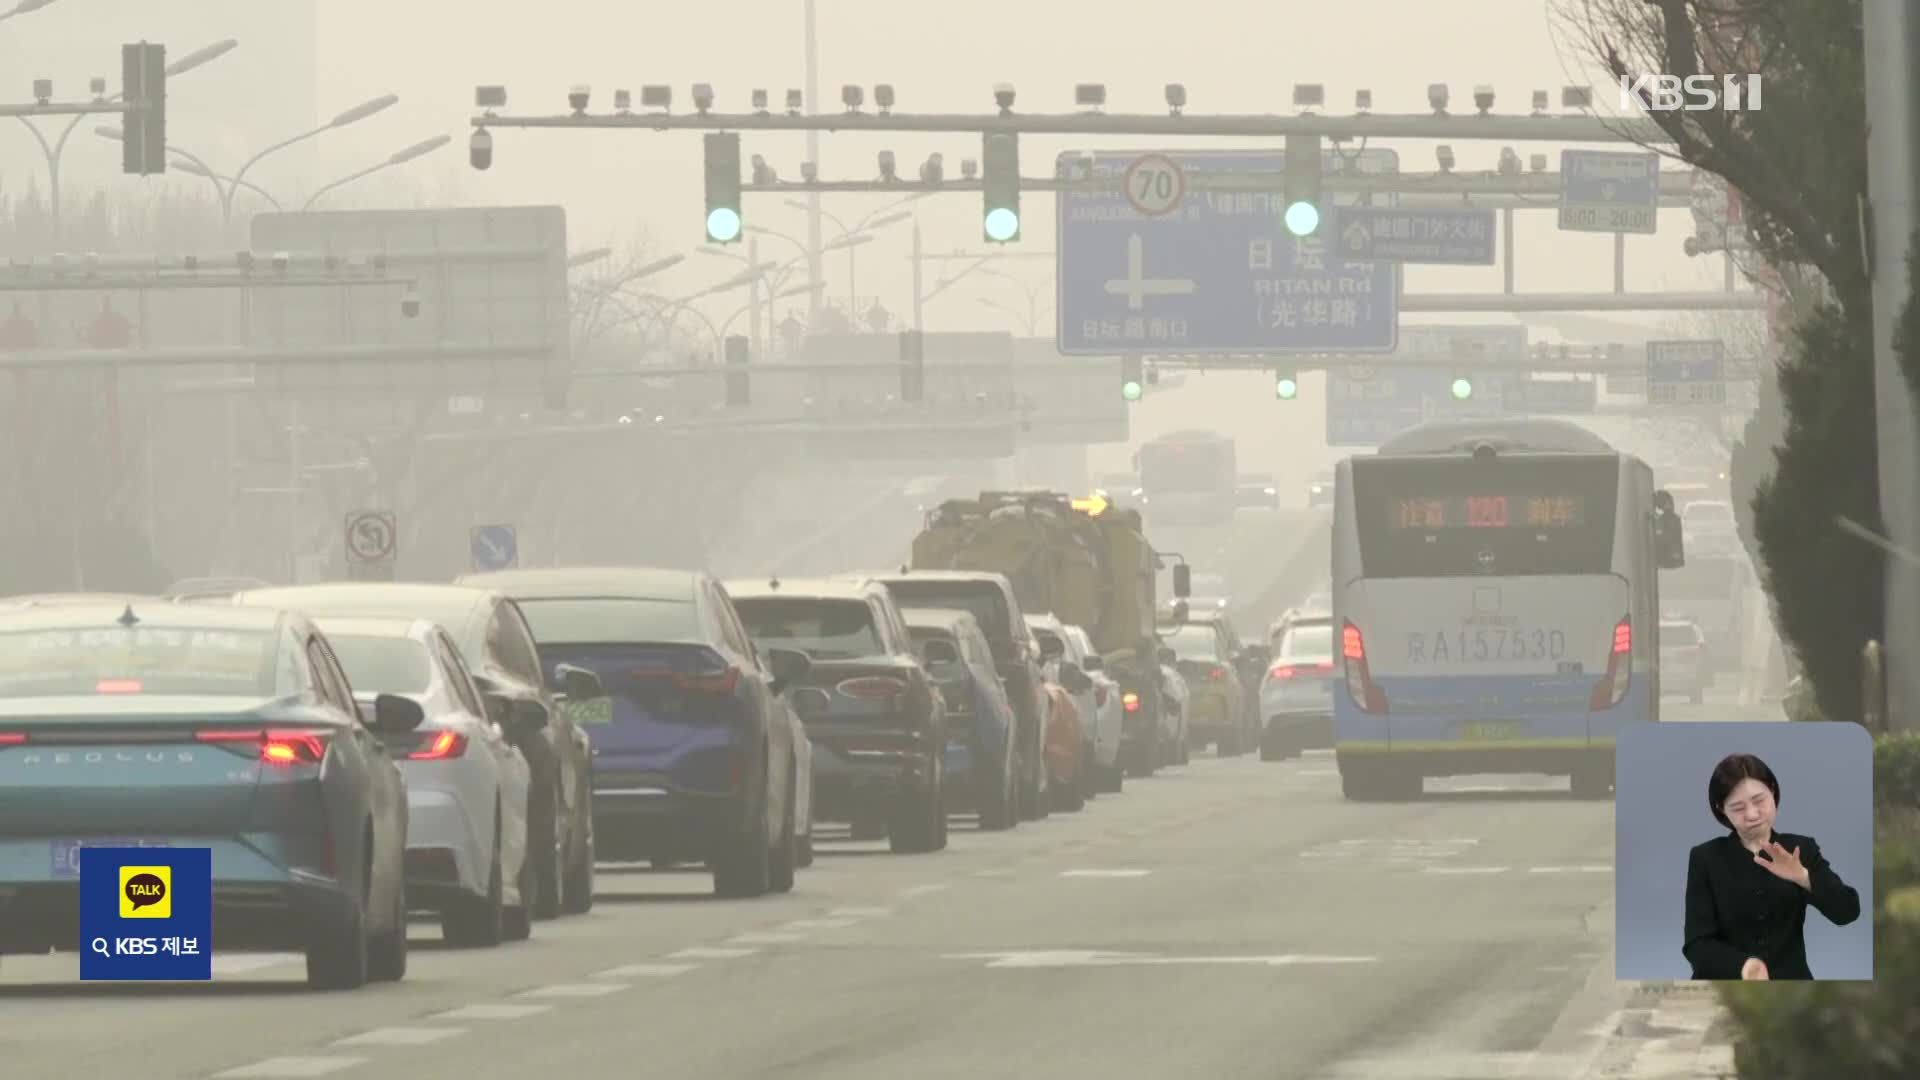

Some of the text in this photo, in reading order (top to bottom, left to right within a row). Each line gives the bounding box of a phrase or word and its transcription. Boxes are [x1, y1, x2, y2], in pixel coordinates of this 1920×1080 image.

[1139, 169, 1173, 202] 70
[1254, 277, 1372, 296] RITAN Rd
[1406, 629, 1566, 664] 京A15753D
[23, 751, 194, 764] AEOLUS
